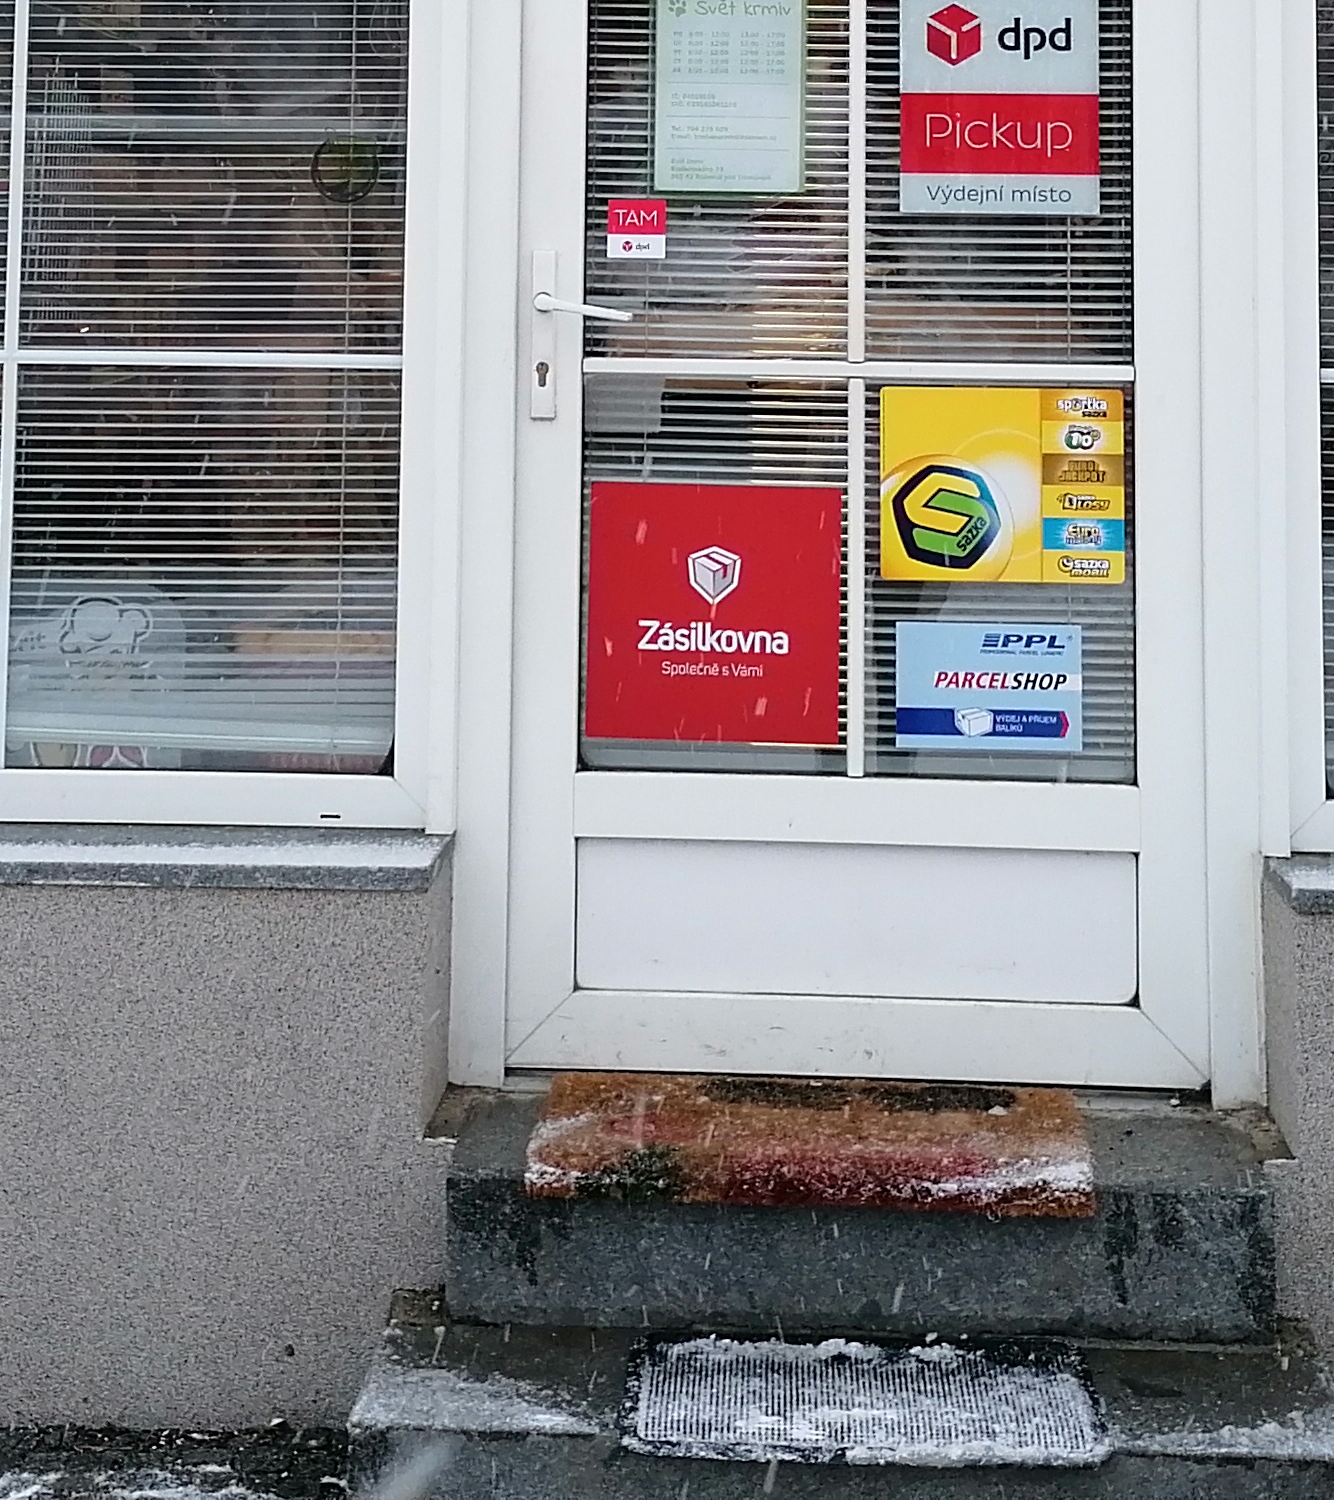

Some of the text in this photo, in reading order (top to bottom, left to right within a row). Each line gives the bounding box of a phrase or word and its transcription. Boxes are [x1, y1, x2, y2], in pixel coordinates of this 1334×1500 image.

[744, 1, 792, 16] krmiv
[997, 17, 1072, 60] dpd
[925, 113, 1073, 152] Pickup
[927, 182, 1072, 204] Výdejní místo
[612, 209, 658, 227] TAM
[1057, 397, 1108, 413] sportka
[1059, 470, 1106, 483] JACKPOT
[637, 619, 789, 654] Zásilkovna
[1001, 633, 1065, 649] PPL
[661, 661, 763, 677] Společně s Vámi
[934, 671, 1067, 690] PARCELSHOP
[995, 714, 1020, 723] VÝDEJ
